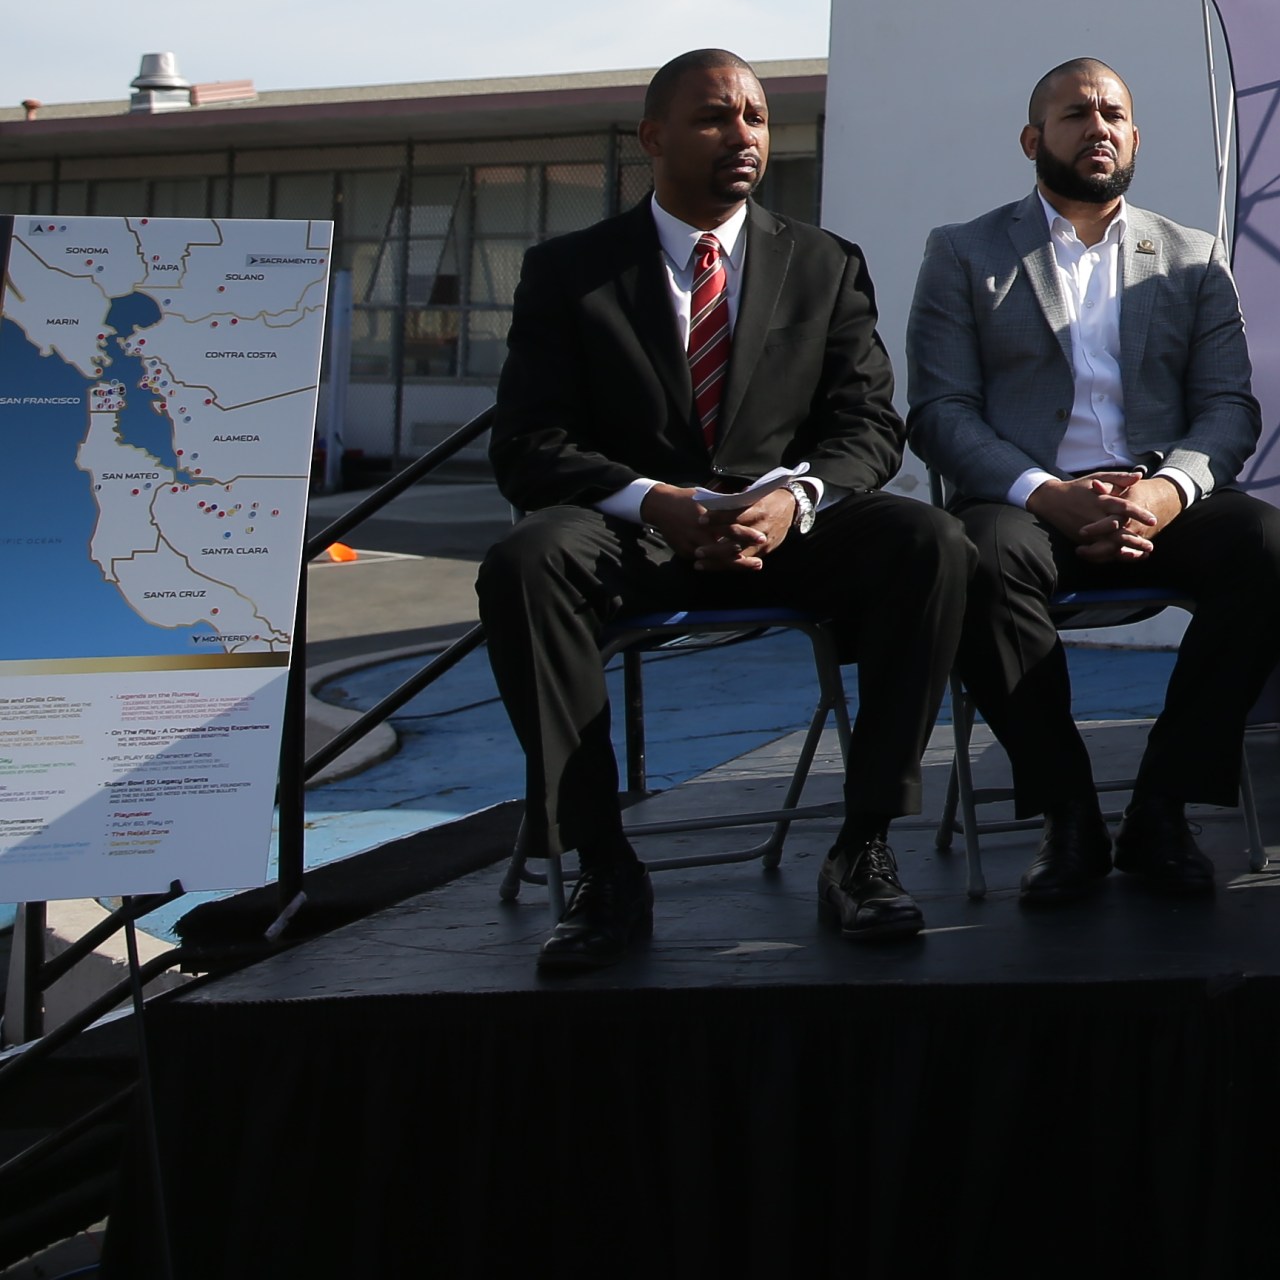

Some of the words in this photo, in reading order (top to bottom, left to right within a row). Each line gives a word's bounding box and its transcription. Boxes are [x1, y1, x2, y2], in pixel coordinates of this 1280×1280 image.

[65, 247, 109, 255] SONOMA
[259, 257, 318, 265] SACRAMENTO
[23, 397, 80, 405] FRANCISCO
[124, 472, 159, 480] MATEO
[201, 547, 234, 555] SANTA
[143, 591, 177, 599] SANTA
[179, 590, 207, 598] CRUZ
[202, 635, 251, 643] MONTEREY
